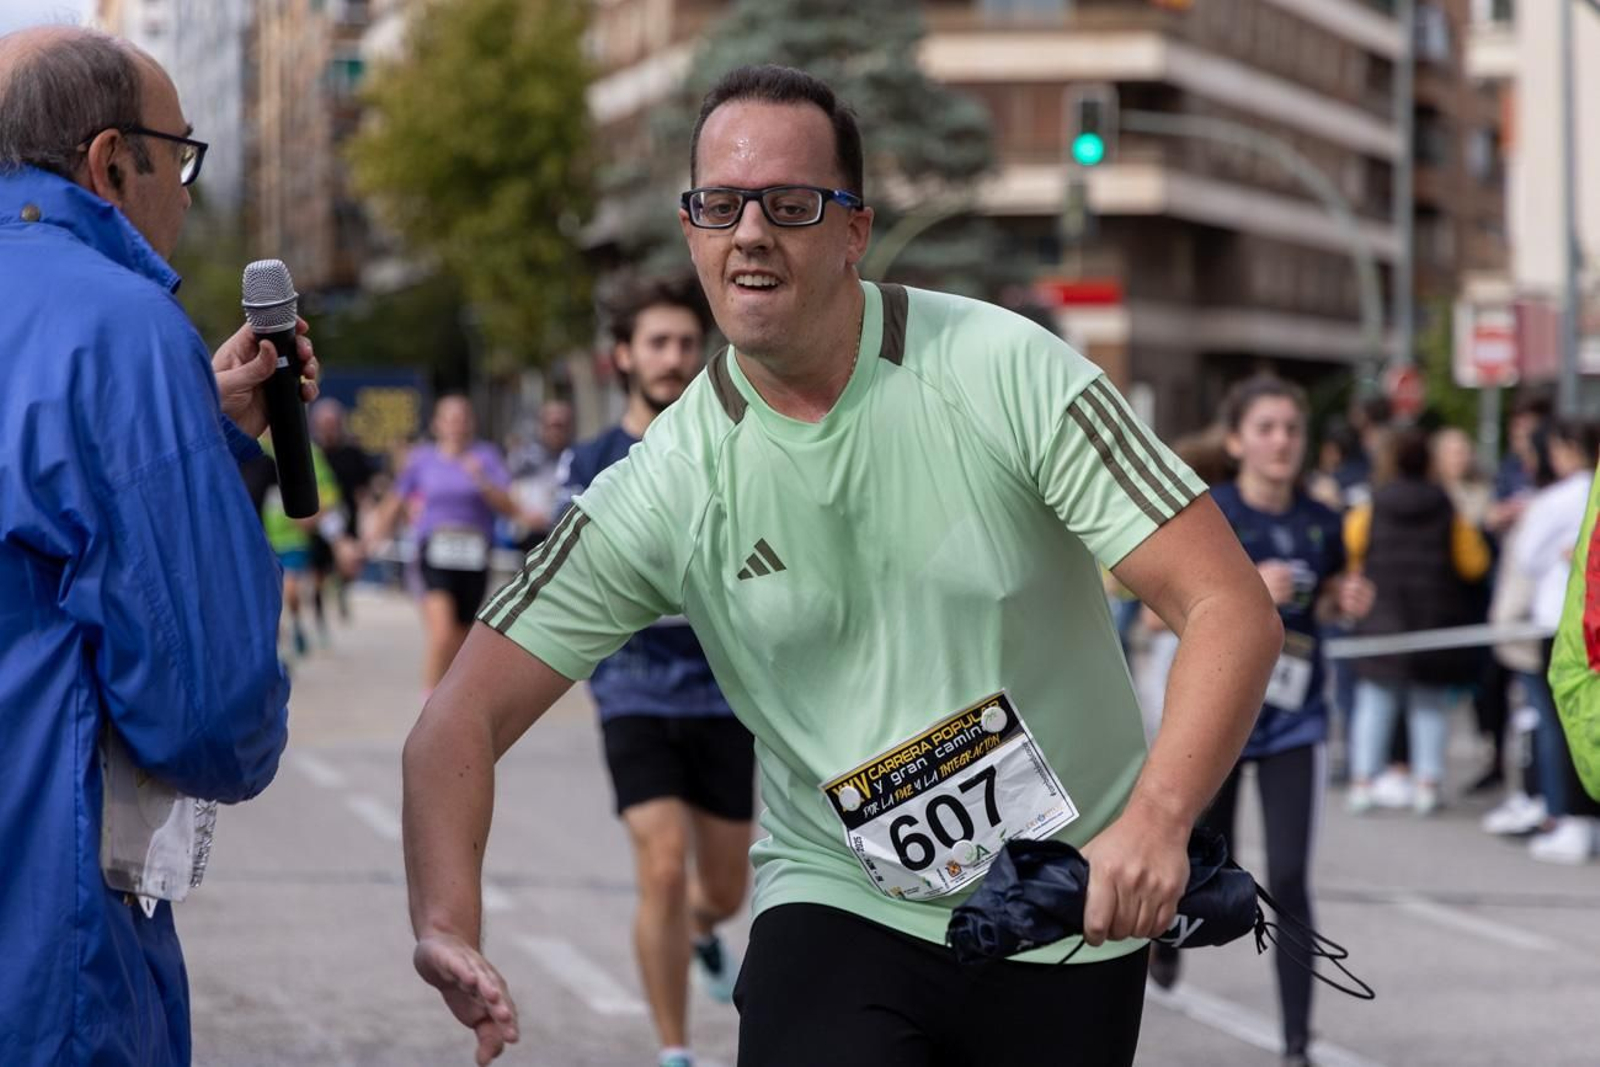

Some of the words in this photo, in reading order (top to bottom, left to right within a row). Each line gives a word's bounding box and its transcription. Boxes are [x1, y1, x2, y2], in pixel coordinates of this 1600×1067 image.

[868, 741, 933, 780] CARRERA
[873, 780, 883, 794] y
[890, 757, 928, 785] gran
[934, 723, 984, 758] camin
[863, 802, 881, 818] POR
[881, 793, 895, 809] LA
[923, 769, 939, 786] LA
[889, 764, 1002, 872] 607
